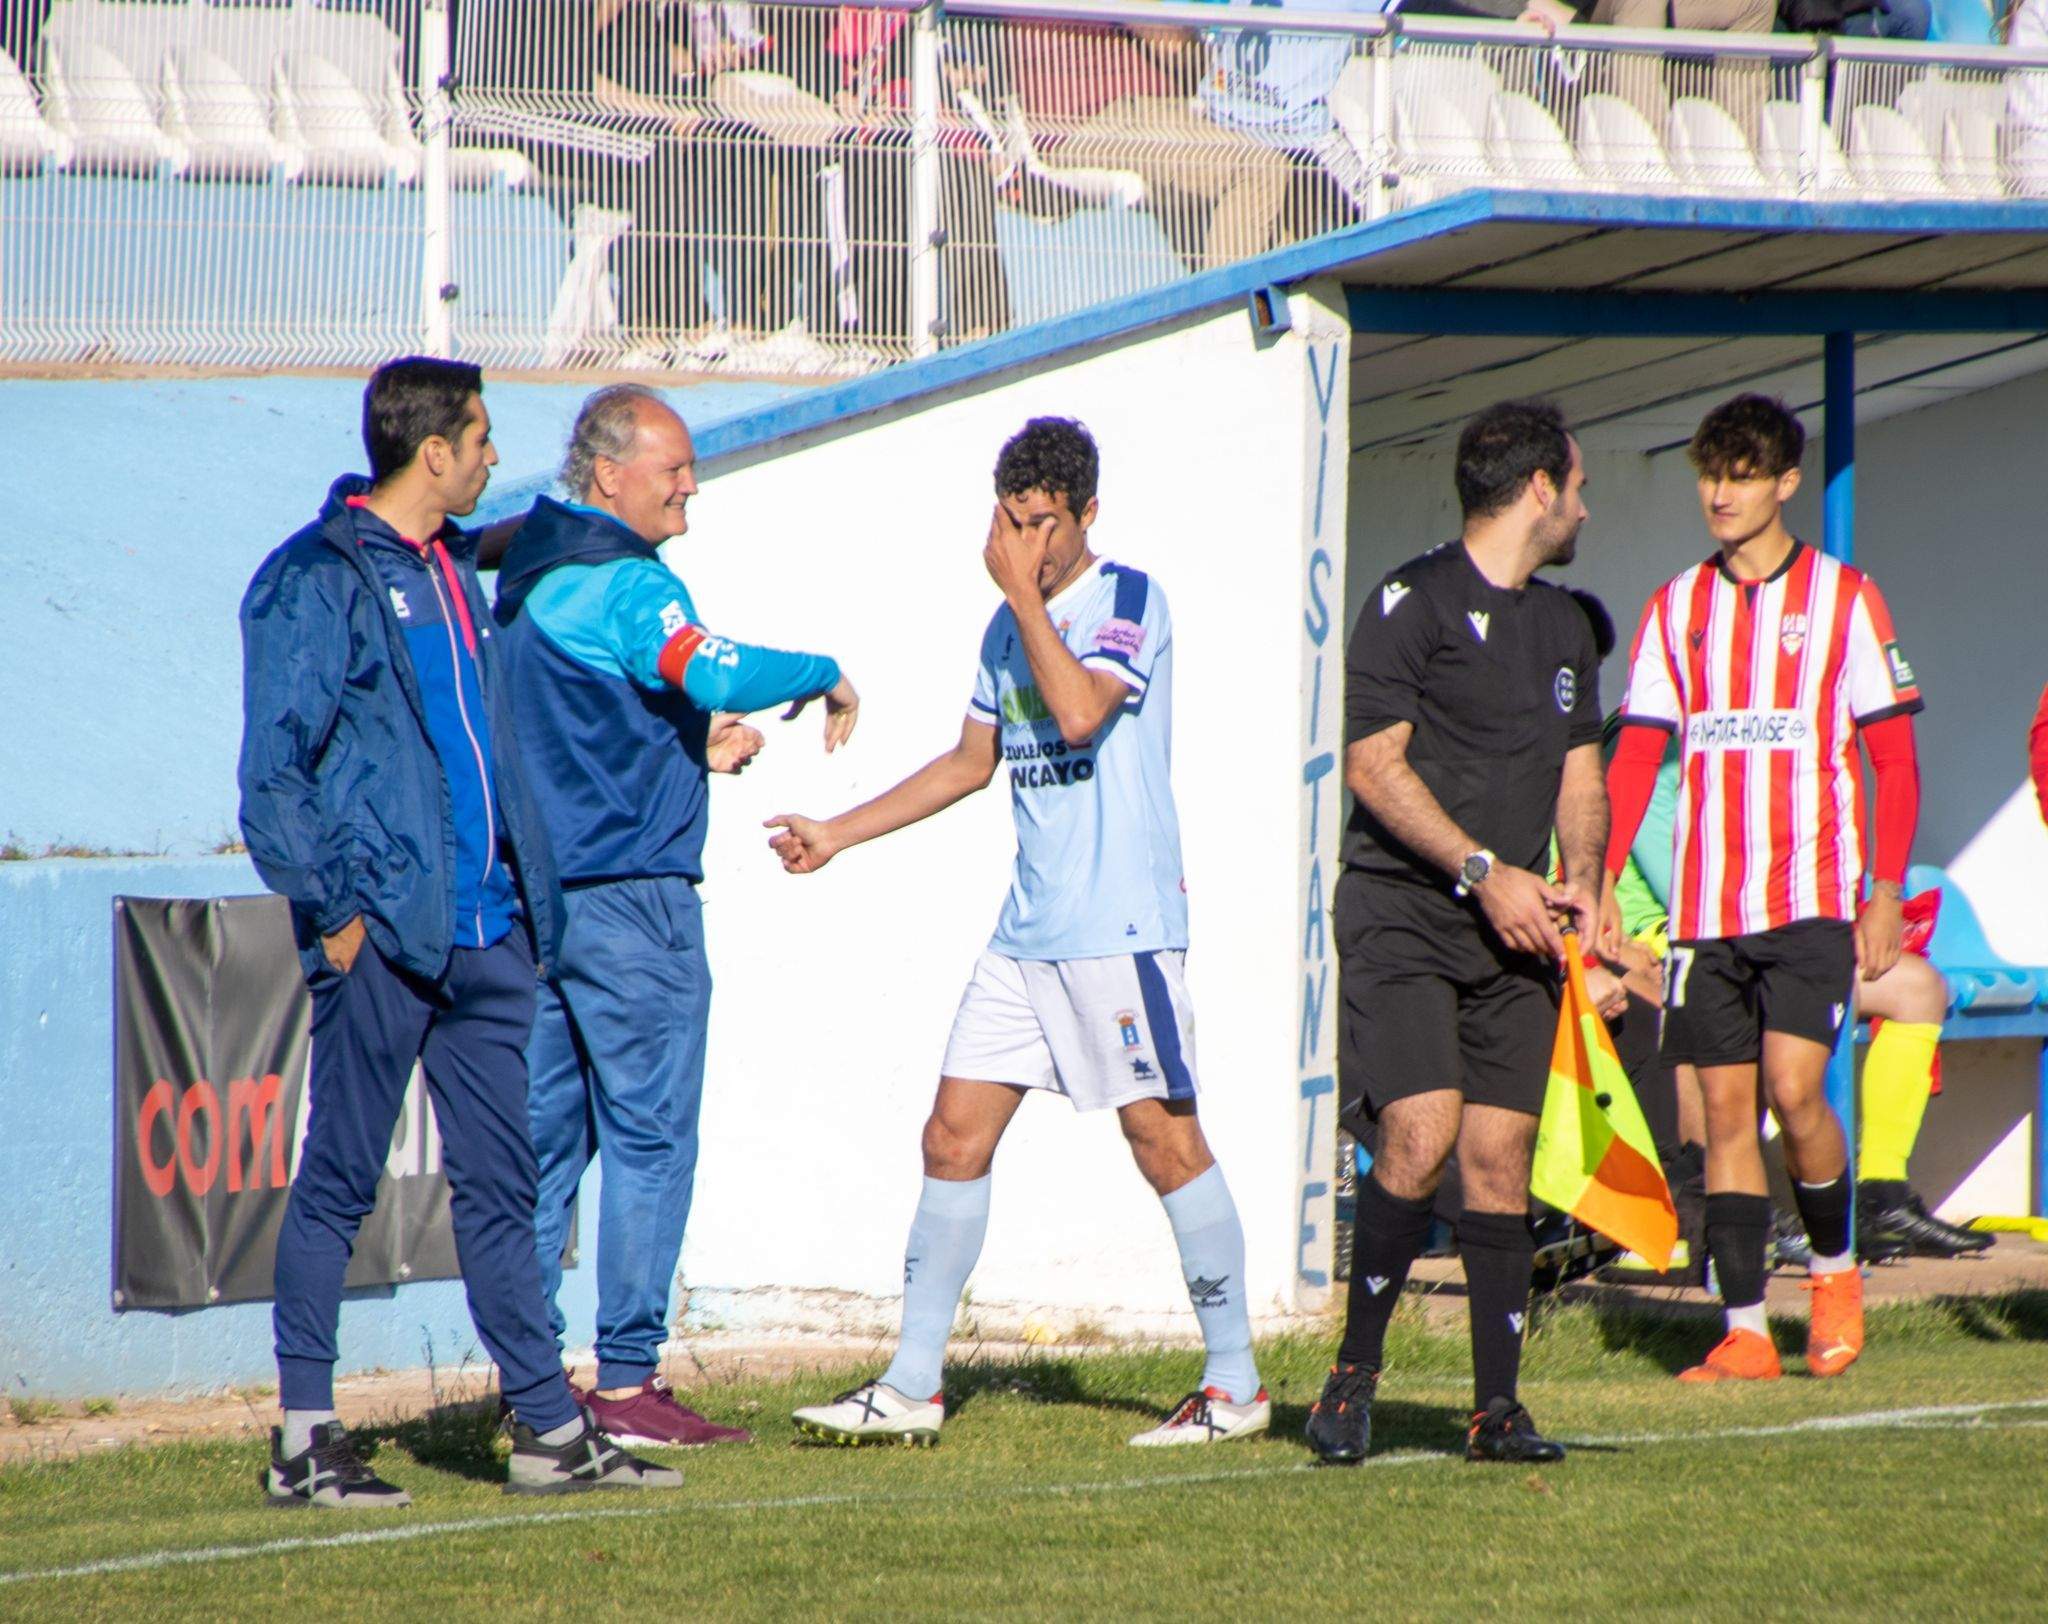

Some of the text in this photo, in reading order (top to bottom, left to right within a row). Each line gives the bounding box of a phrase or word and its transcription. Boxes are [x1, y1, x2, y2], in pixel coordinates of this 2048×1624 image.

[1004, 740, 1068, 761] ZULEJOS
[1011, 758, 1094, 789] NCAYO
[1298, 341, 1338, 1287] VISITANTE
